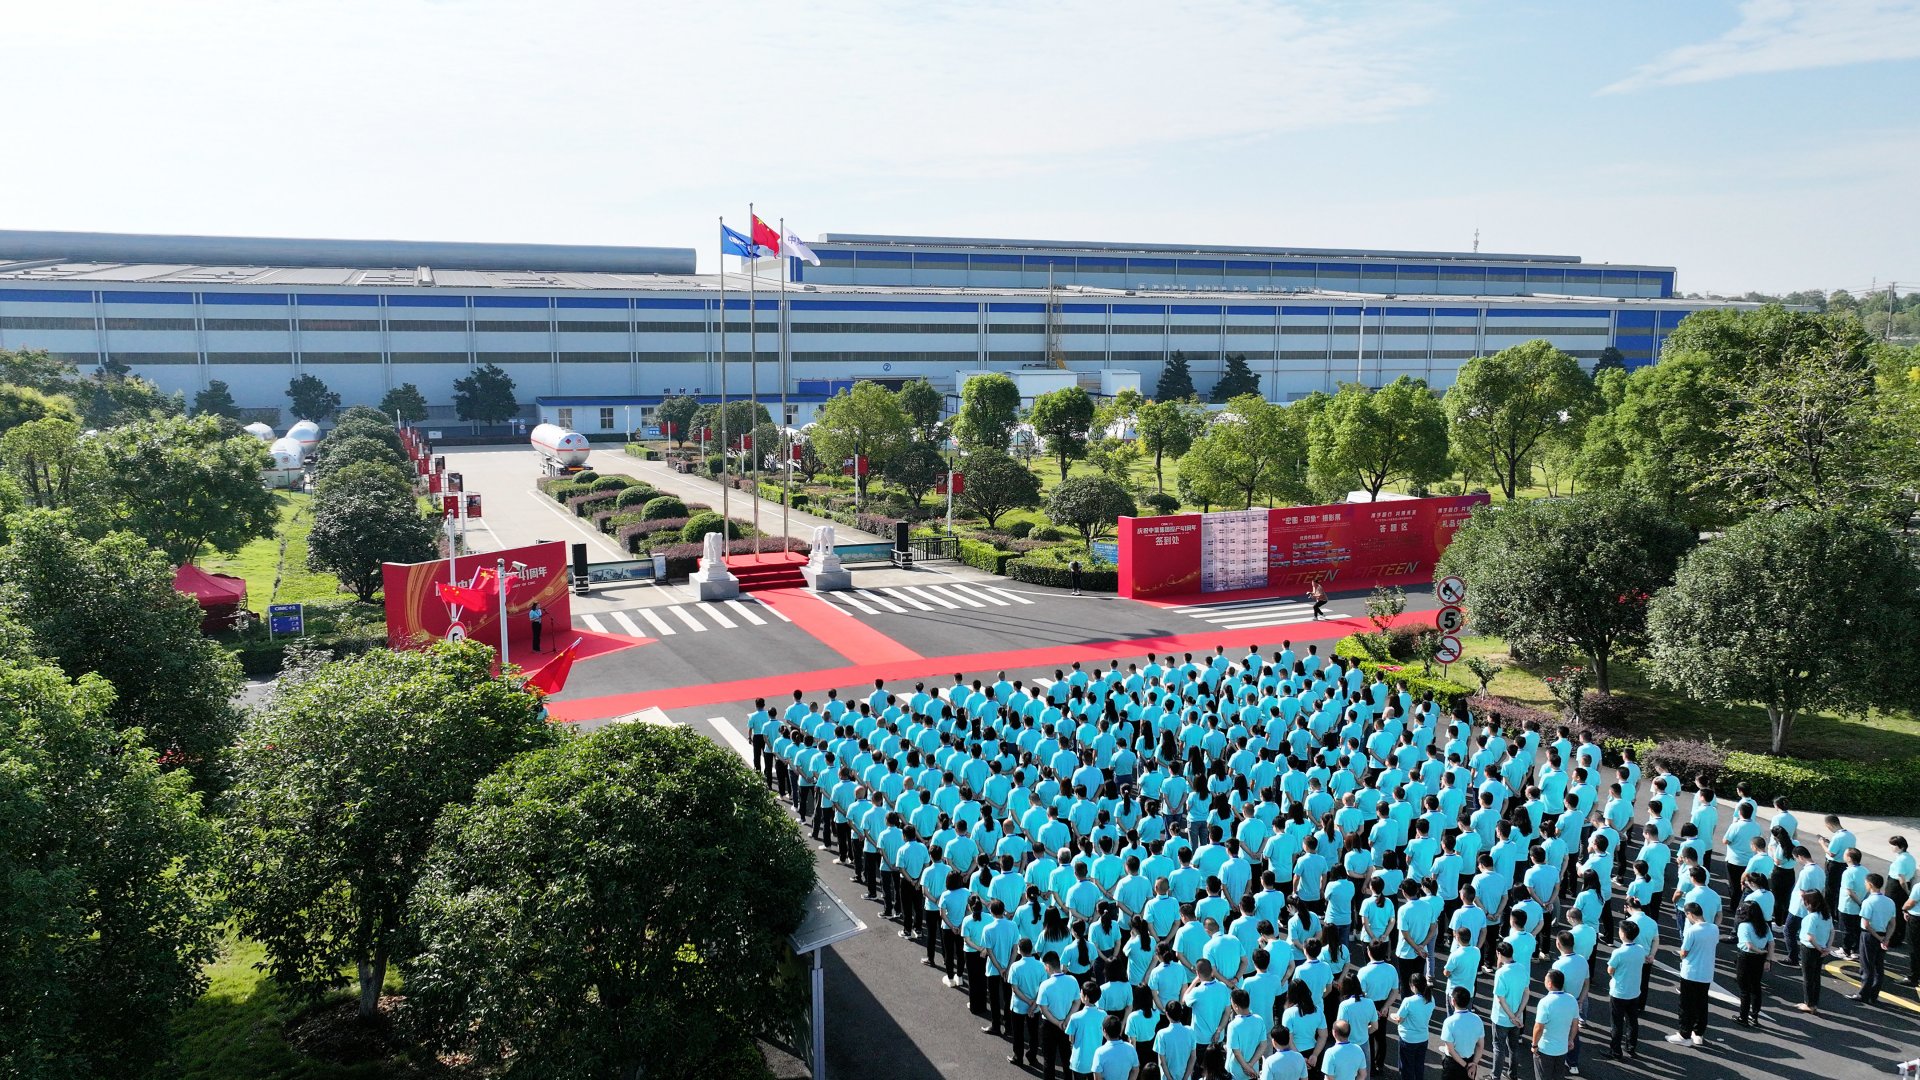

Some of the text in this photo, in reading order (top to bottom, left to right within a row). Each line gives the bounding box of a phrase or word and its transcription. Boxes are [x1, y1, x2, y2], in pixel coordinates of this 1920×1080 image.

[1380, 523, 1408, 532] 答题区
[1155, 536, 1179, 546] 签到处
[1444, 612, 1455, 629] 5
